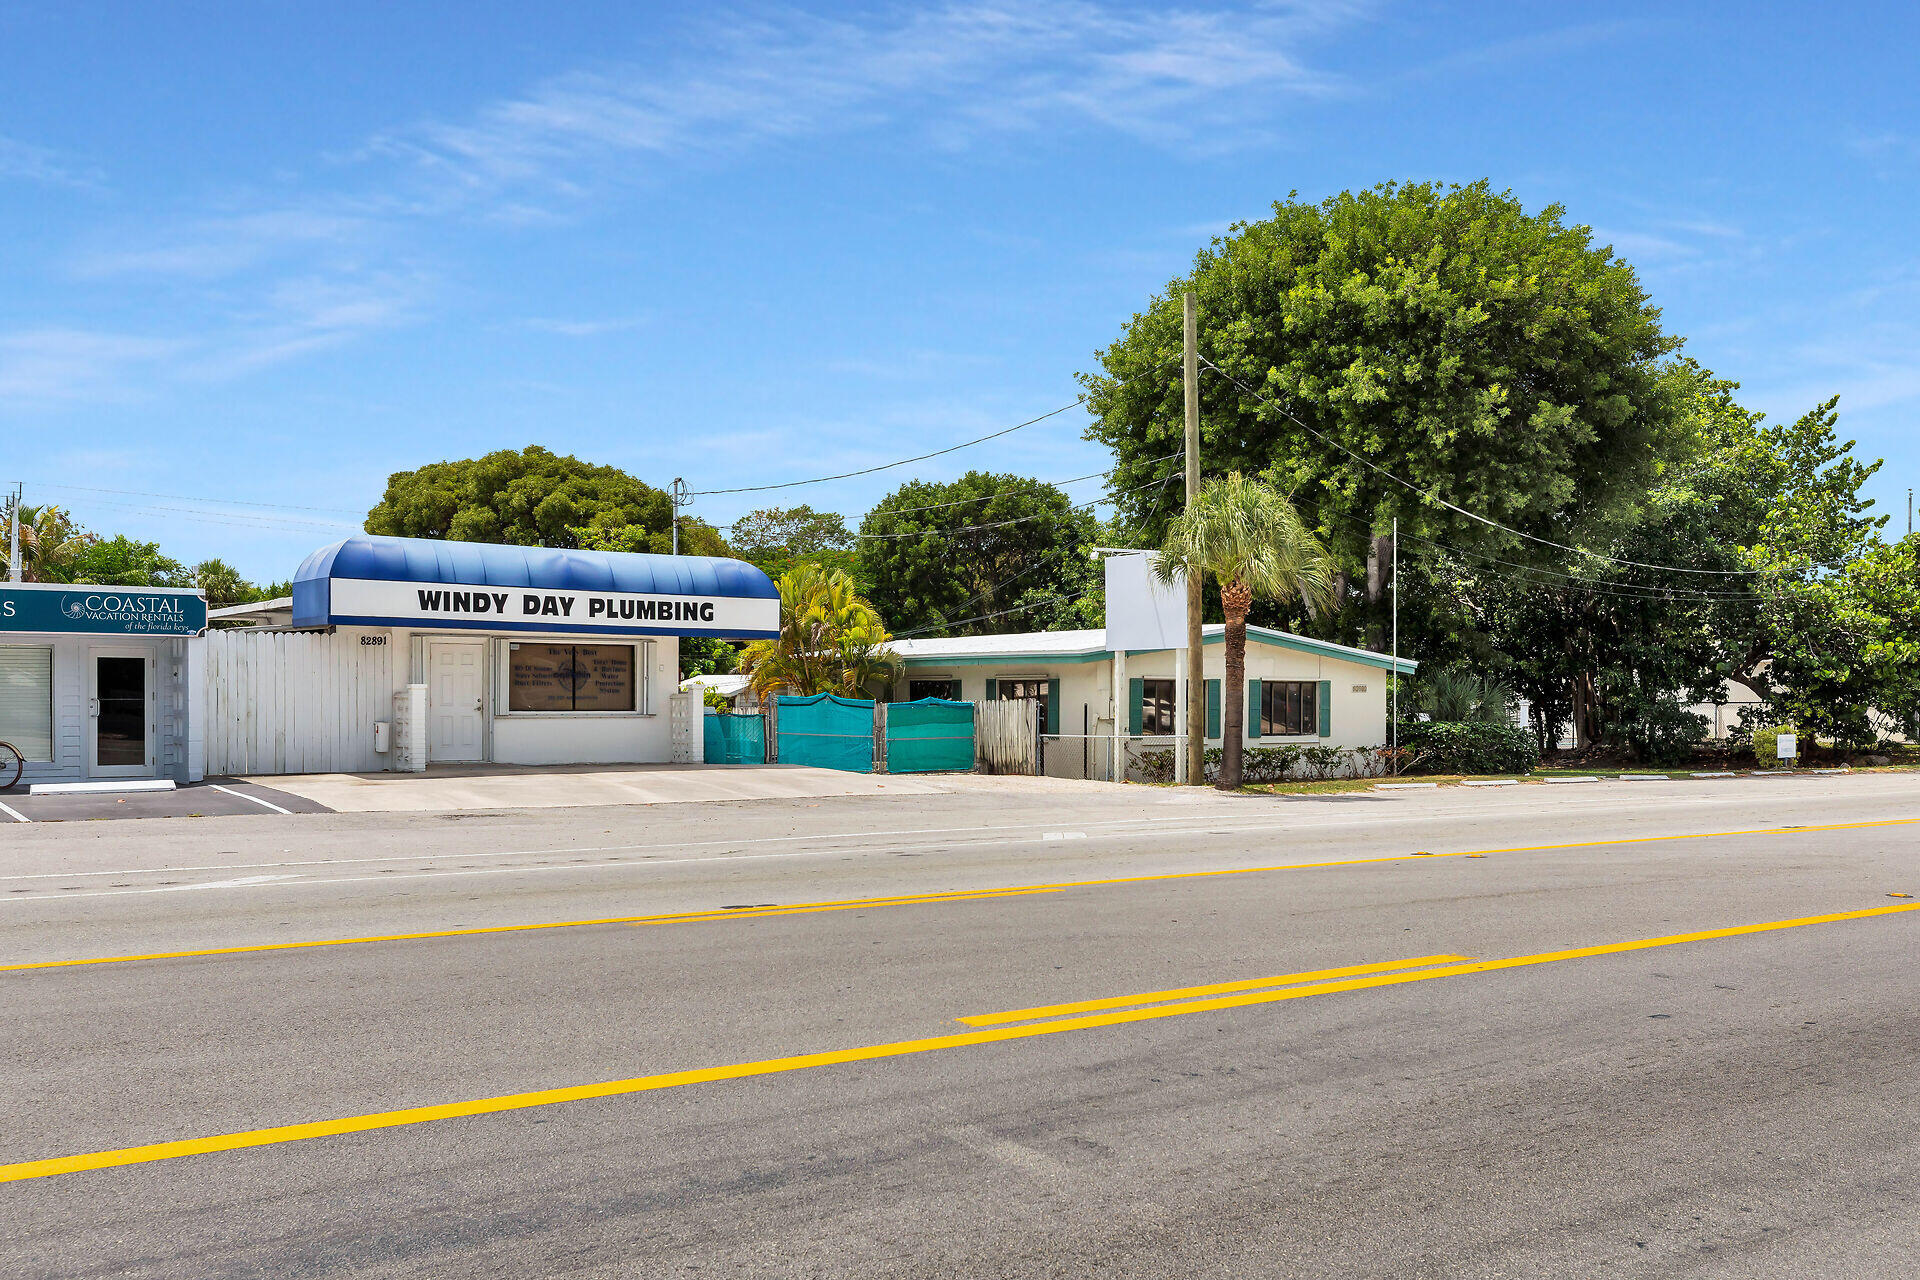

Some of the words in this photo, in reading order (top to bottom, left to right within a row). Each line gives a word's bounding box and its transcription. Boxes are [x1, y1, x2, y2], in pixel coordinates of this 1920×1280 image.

[85, 595, 184, 614] COASTAL
[417, 589, 509, 614] WINDY
[522, 594, 576, 617] DAY
[589, 598, 715, 622] PLUMBING
[86, 611, 140, 621] VACATION
[141, 613, 184, 623] RENTALS
[124, 622, 134, 632] of
[134, 622, 146, 630] the
[147, 622, 172, 632] florida
[174, 623, 190, 633] keys
[360, 635, 387, 646] 82891
